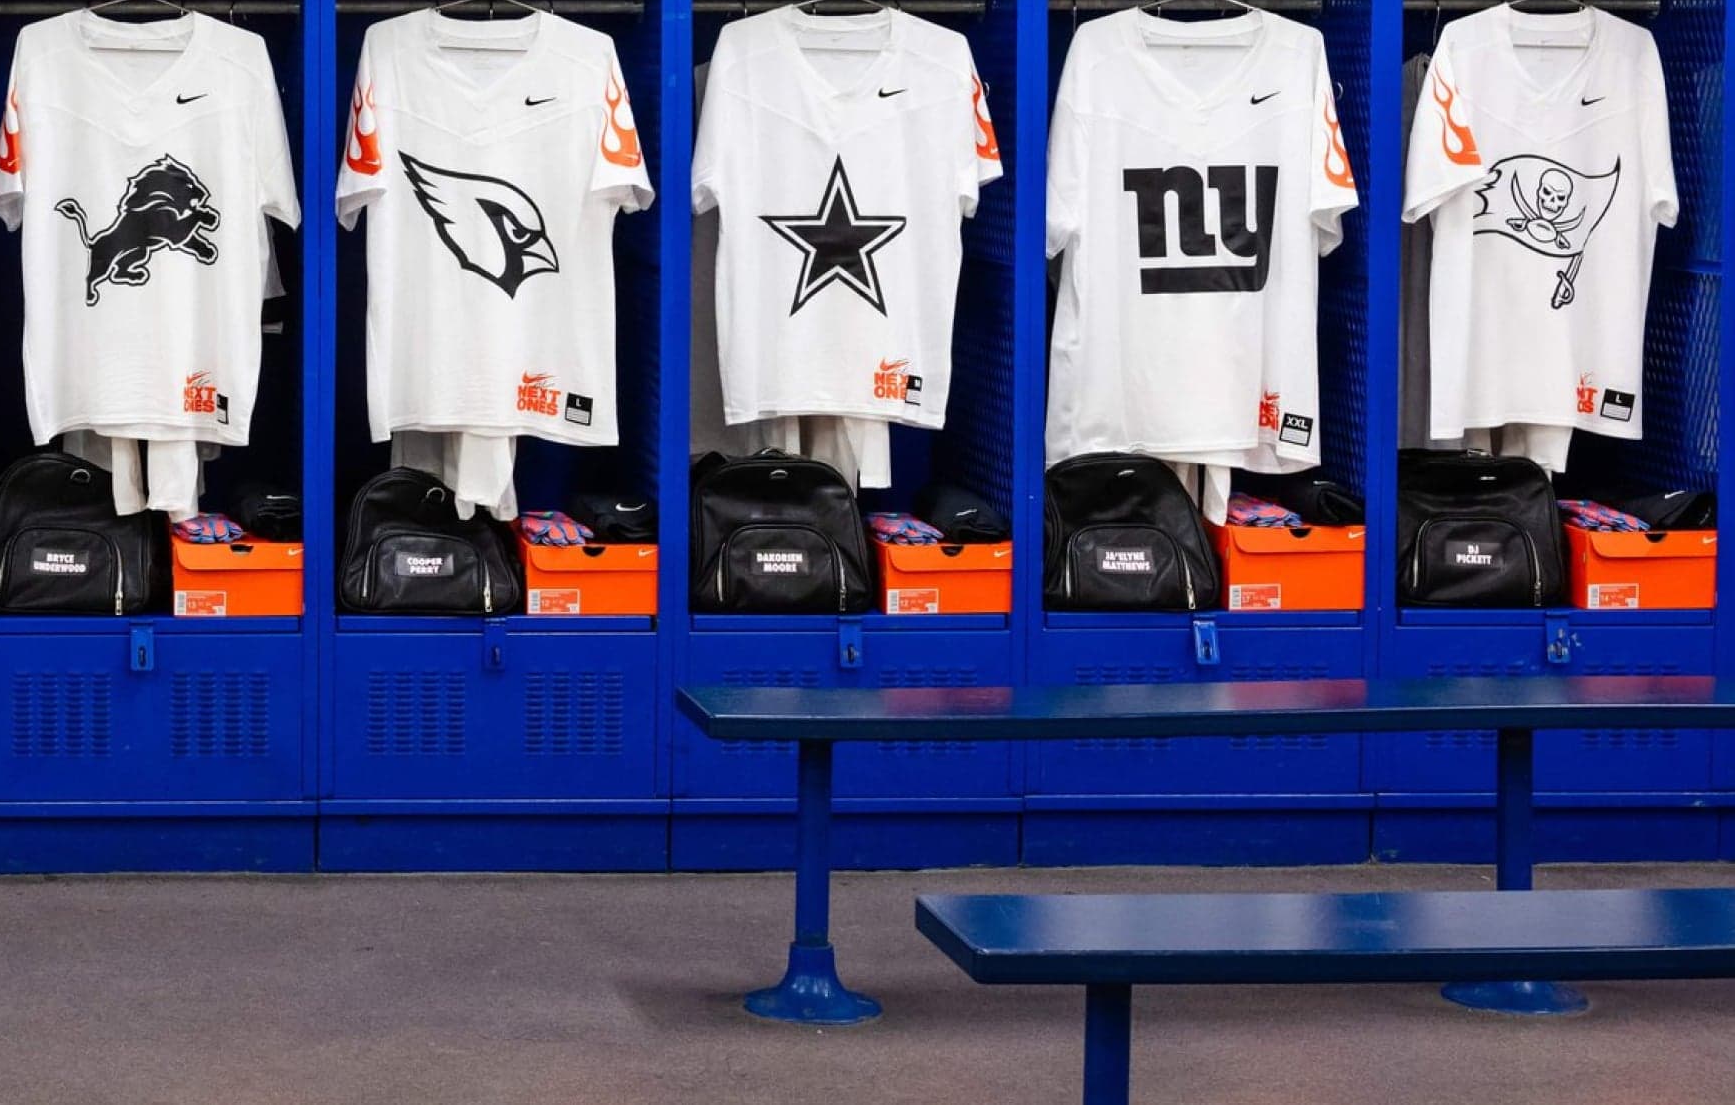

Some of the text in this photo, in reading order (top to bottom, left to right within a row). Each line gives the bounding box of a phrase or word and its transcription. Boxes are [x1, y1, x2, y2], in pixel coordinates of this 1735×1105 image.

[1123, 165, 1279, 295] ny
[516, 384, 562, 404] NEXT
[1616, 393, 1623, 404] L
[516, 398, 560, 416] ONES
[575, 398, 582, 408] L
[1286, 416, 1310, 430] XXL
[1467, 544, 1480, 554] DJ
[45, 553, 75, 563] BRYCE
[405, 556, 443, 566] COOPER
[1455, 553, 1493, 565] PICKETT
[33, 562, 87, 573] UNDERWOOD
[409, 564, 440, 574] PERRY
[763, 562, 797, 573] MOORE
[1102, 560, 1151, 571] MATTHEWS
